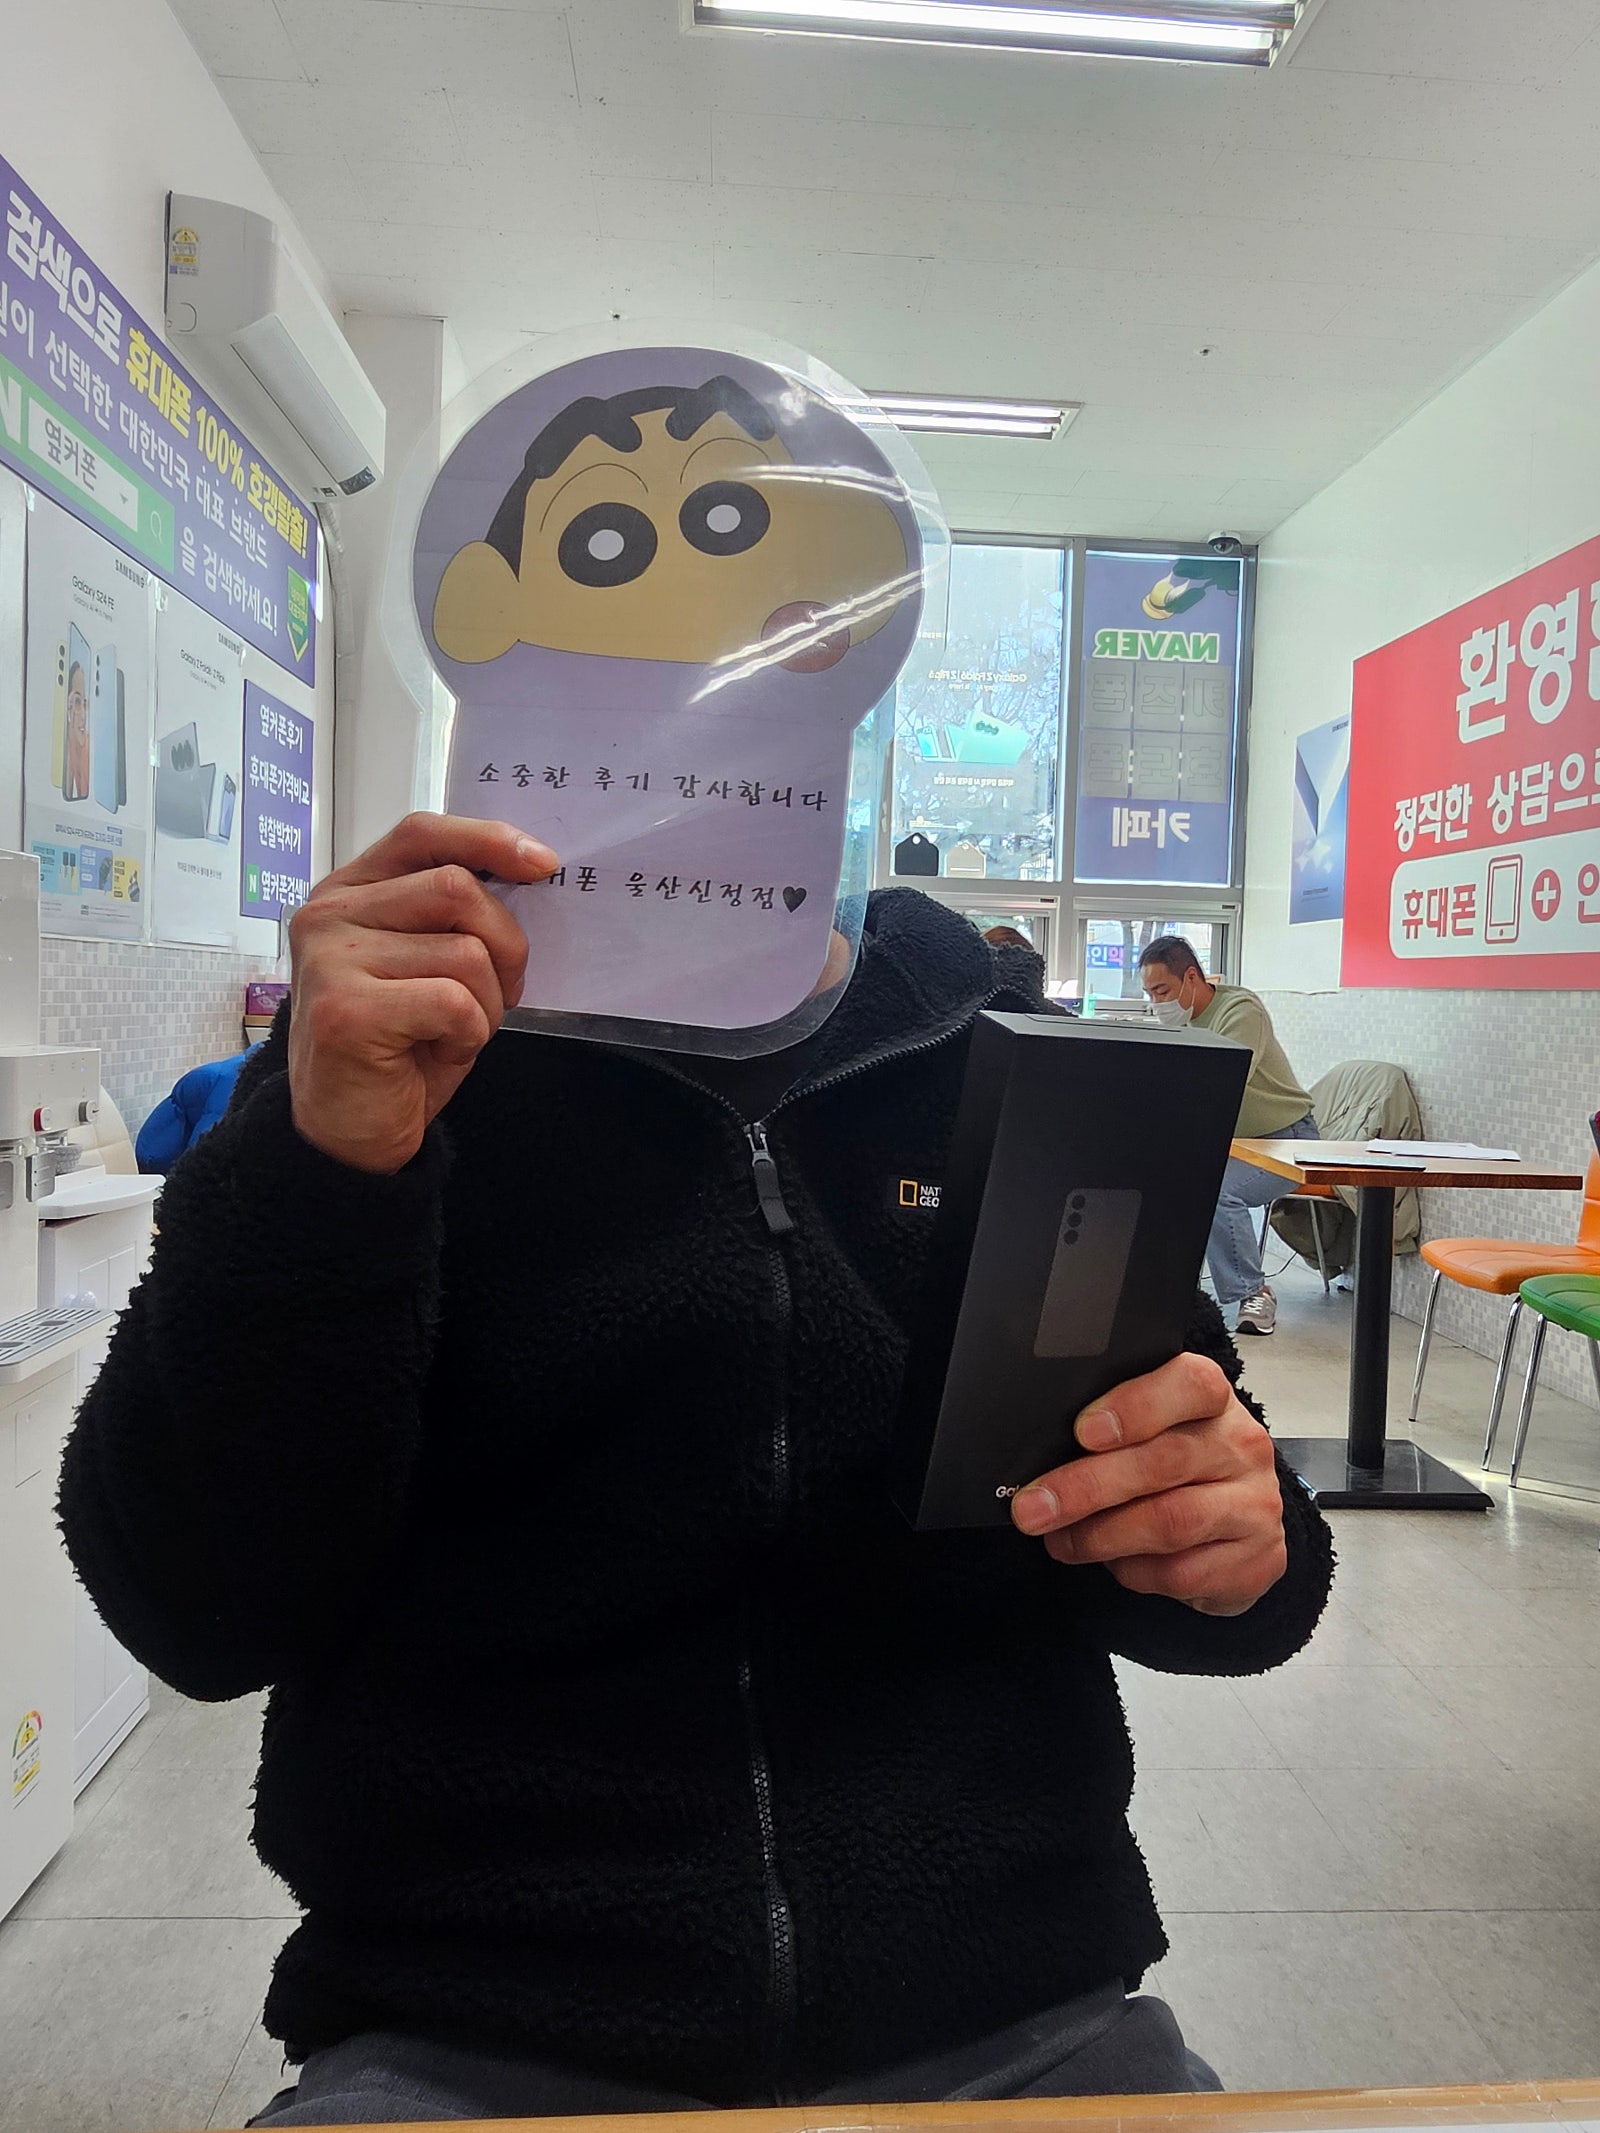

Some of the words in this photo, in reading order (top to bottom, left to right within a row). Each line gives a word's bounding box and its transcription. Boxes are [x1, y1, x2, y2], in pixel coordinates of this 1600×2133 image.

[6, 190, 123, 366] 검색으로
[125, 326, 192, 439] 휴대폰
[196, 405, 245, 492] 100%
[247, 462, 309, 560] 호갱탈출!
[45, 329, 114, 431] 선택한
[119, 400, 191, 503] 대한민국
[195, 474, 225, 530] 대표
[229, 507, 268, 569] 브랜드
[44, 418, 97, 491] 옆커폰
[180, 526, 197, 577] 을
[203, 543, 278, 637] 검색하세요!
[72, 576, 96, 601] Galaxy
[96, 590, 107, 606] S24
[108, 596, 115, 611] FE
[115, 559, 145, 588] SAMSUNG
[1456, 582, 1600, 745] 환영
[260, 704, 303, 754] 옆커폰후기
[250, 754, 310, 806] 휴대폰가격비교
[478, 762, 571, 789] 소중한
[594, 767, 650, 792] 후기
[673, 773, 829, 812] 감사합니다
[1393, 782, 1473, 852] 정직한
[1487, 747, 1600, 835] 상담으
[258, 813, 302, 855] 현찰박치기
[249, 873, 257, 893] N
[625, 871, 776, 911] 울산신정점
[1402, 883, 1476, 940] 휴대폰
[920, 1185, 942, 1196] NAT
[995, 1484, 1020, 1498] Ga
